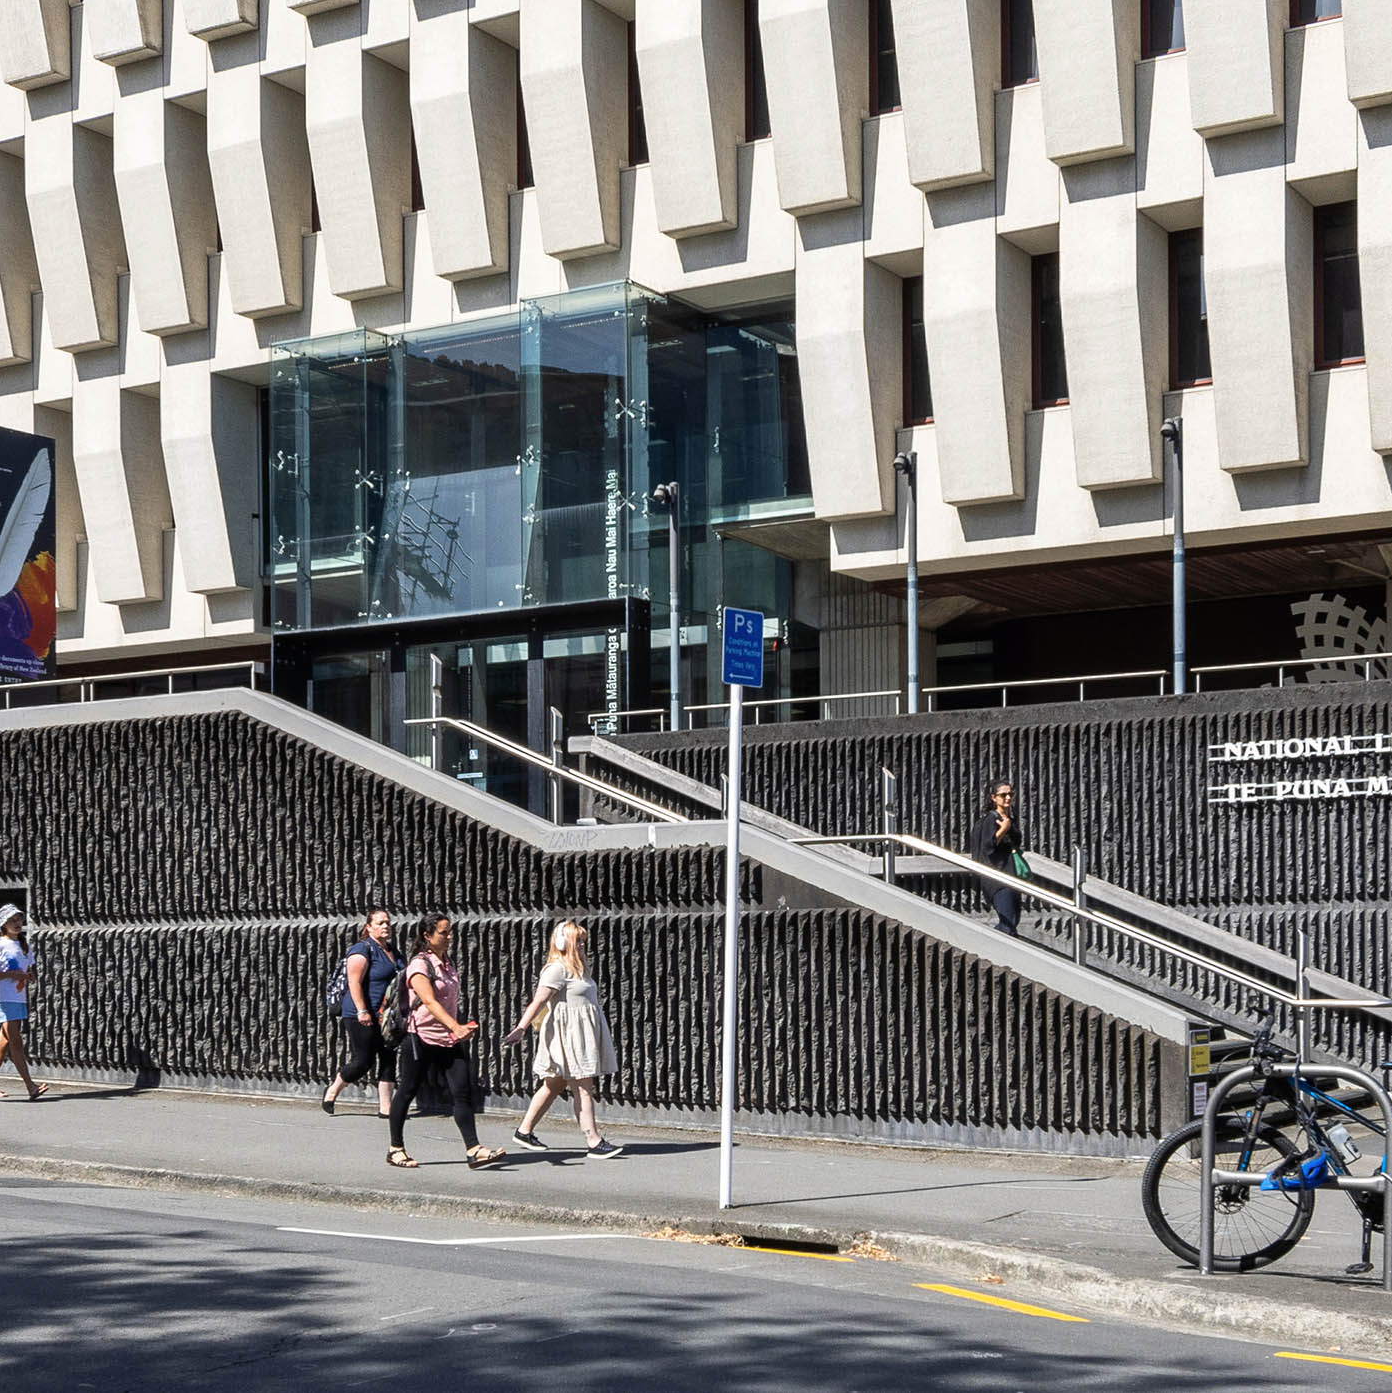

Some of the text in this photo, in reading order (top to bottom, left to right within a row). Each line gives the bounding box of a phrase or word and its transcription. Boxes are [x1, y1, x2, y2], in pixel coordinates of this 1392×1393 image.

[605, 469, 617, 489] Mai
[605, 491, 617, 525] Haere
[605, 527, 617, 547] Mai
[605, 549, 617, 573] Nau
[1224, 735, 1359, 762] NATIONAL
[1224, 782, 1257, 803] TE
[1276, 778, 1351, 801] PUNA
